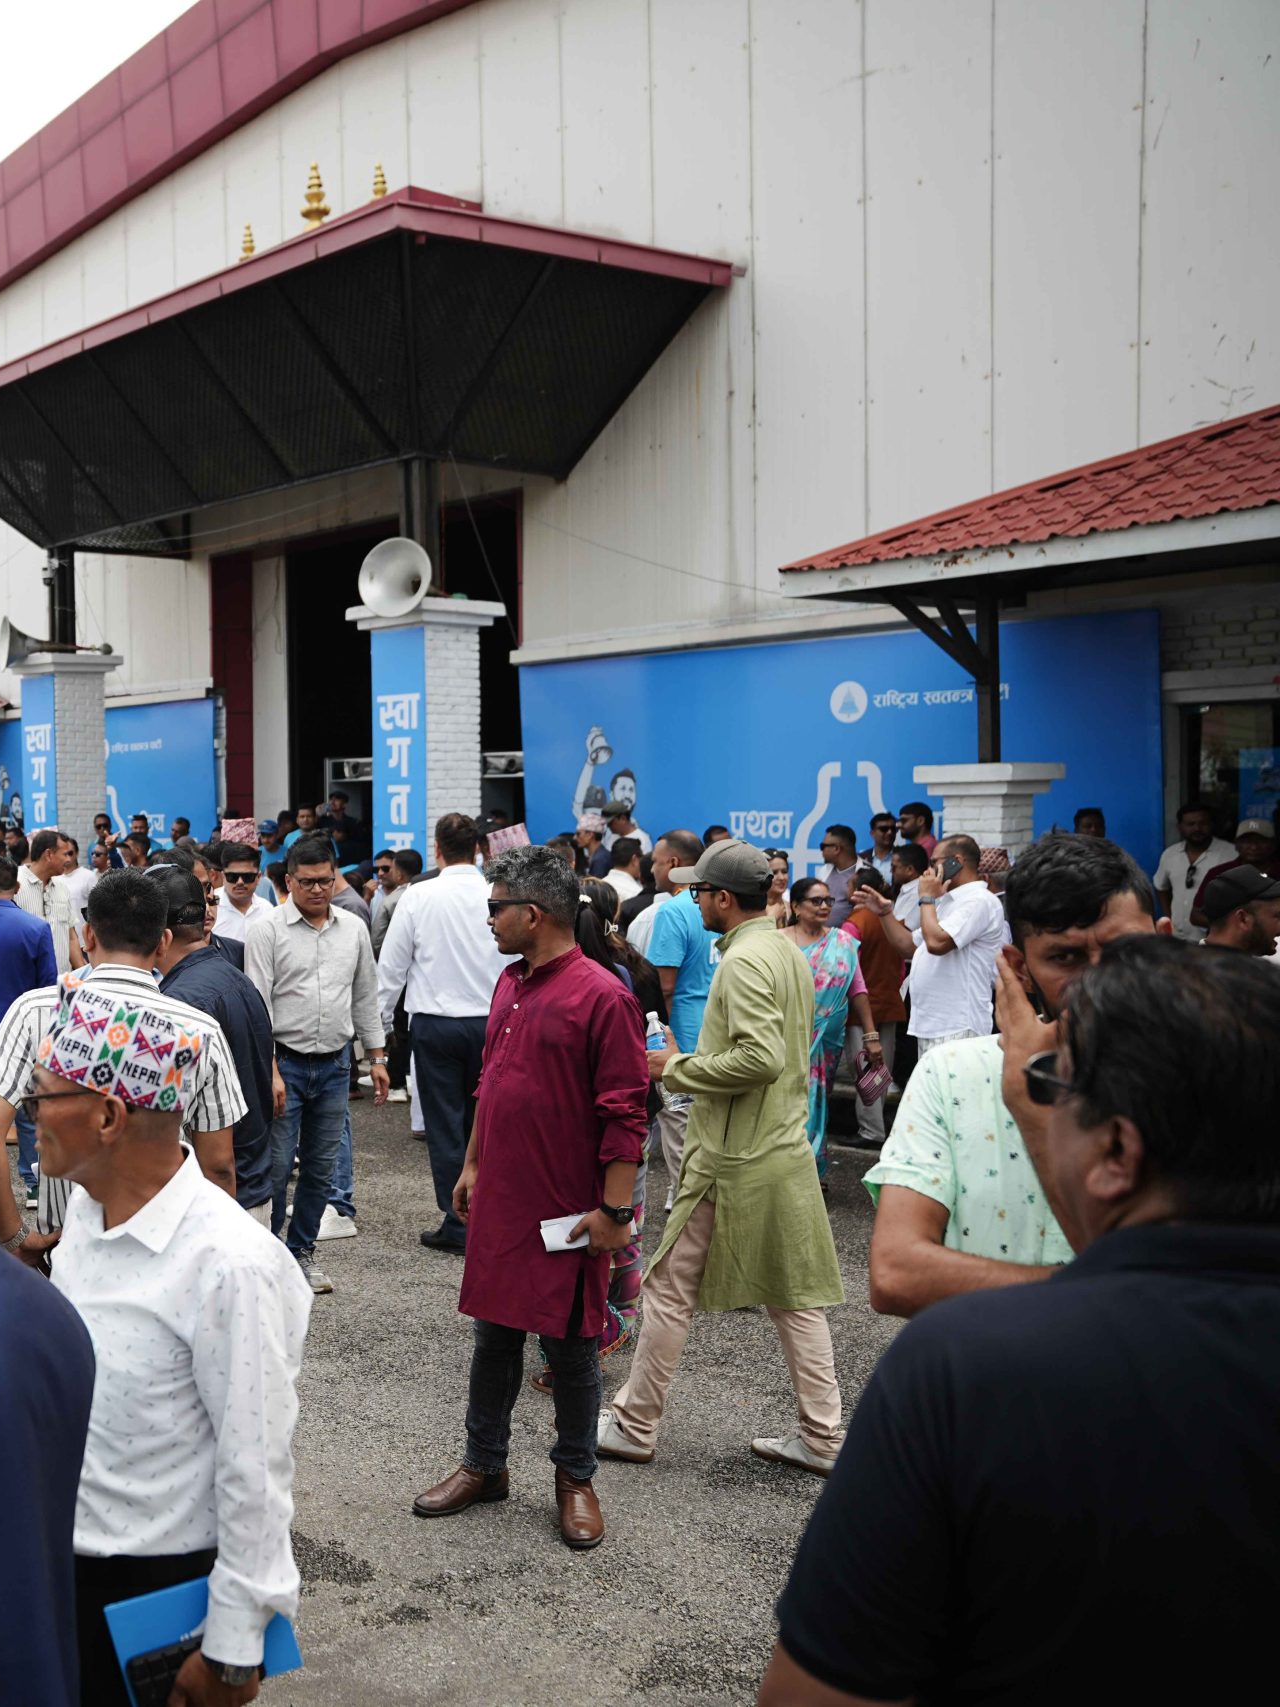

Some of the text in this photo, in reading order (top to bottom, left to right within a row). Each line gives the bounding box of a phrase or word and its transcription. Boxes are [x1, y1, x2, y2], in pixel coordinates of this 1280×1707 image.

[729, 810, 794, 839] प्रथम
[77, 989, 116, 1012] NEPAL
[140, 1011, 176, 1037] NEPAL
[57, 1035, 95, 1062] NEPAL
[121, 1060, 162, 1087] NEPAL
